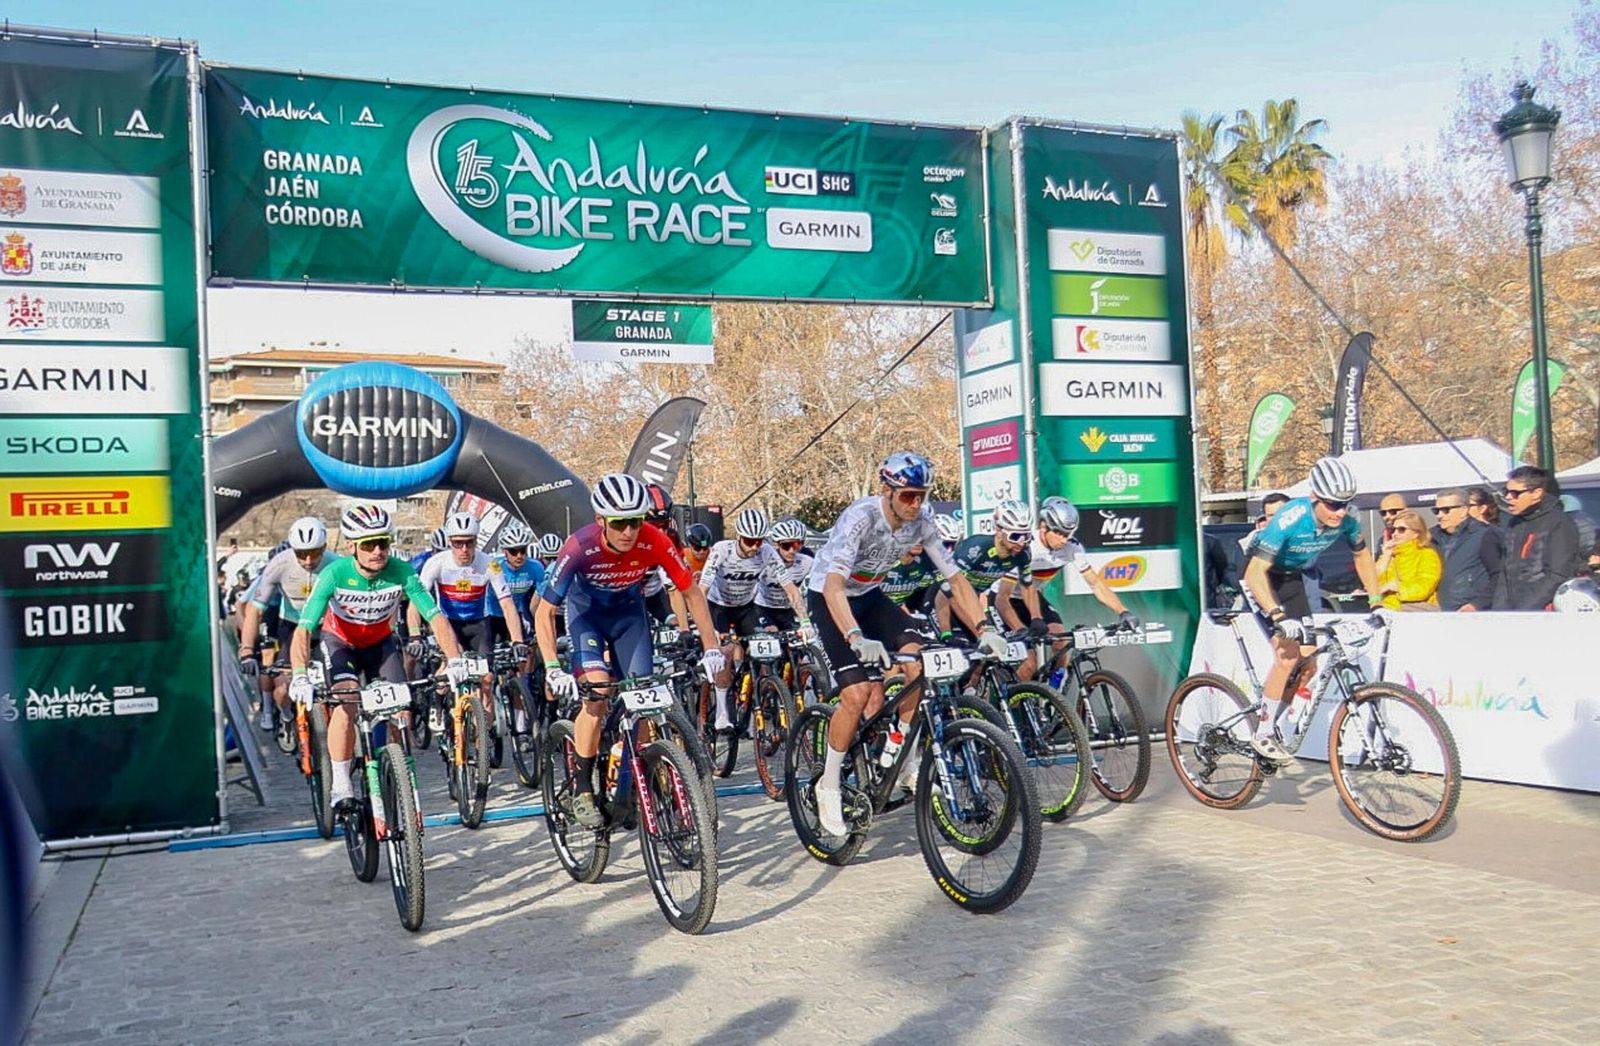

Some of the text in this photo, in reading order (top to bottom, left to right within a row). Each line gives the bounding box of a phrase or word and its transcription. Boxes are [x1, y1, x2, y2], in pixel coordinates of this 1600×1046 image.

[239, 95, 331, 125] Andalucía
[263, 149, 363, 177] GRANADA
[500, 130, 750, 204] Andalucía
[774, 171, 813, 190] UCI
[922, 166, 965, 181] octagon
[34, 185, 122, 200] AYUNTAMIENTO
[264, 174, 320, 199] JAÉN
[455, 186, 487, 196] YEARS
[1040, 176, 1121, 206] Andalucía
[42, 199, 115, 211] DE GRANADA
[265, 201, 364, 230] CÓRDOBA
[506, 193, 753, 247] BIKE RACE
[778, 221, 861, 239] GARMIN
[40, 250, 123, 262] AYUNTAMIENTO
[1097, 246, 1142, 258] Diputación
[1109, 257, 1144, 266] Granada
[41, 262, 55, 271] DE
[47, 301, 125, 315] AYUNTAMIENTO
[606, 308, 681, 323] STAGE 1
[47, 317, 61, 329] DE
[615, 325, 673, 340] GRANADA
[620, 348, 671, 358] GARMIN
[966, 384, 1013, 408] GARMIN
[1066, 380, 1163, 399] GARMIN
[1342, 366, 1360, 454] cannondale
[518, 478, 574, 500] garmin.com
[10, 491, 130, 517] PIRELLI
[1101, 516, 1144, 536] NDL
[36, 570, 109, 581] northwave
[757, 641, 772, 654] 6-1
[934, 653, 953, 672] 9-1
[26, 684, 110, 706] Andalucía
[375, 685, 398, 704] 3-1
[634, 689, 661, 704] 3-2
[26, 704, 64, 721] BIKE
[67, 702, 113, 719] RACE
